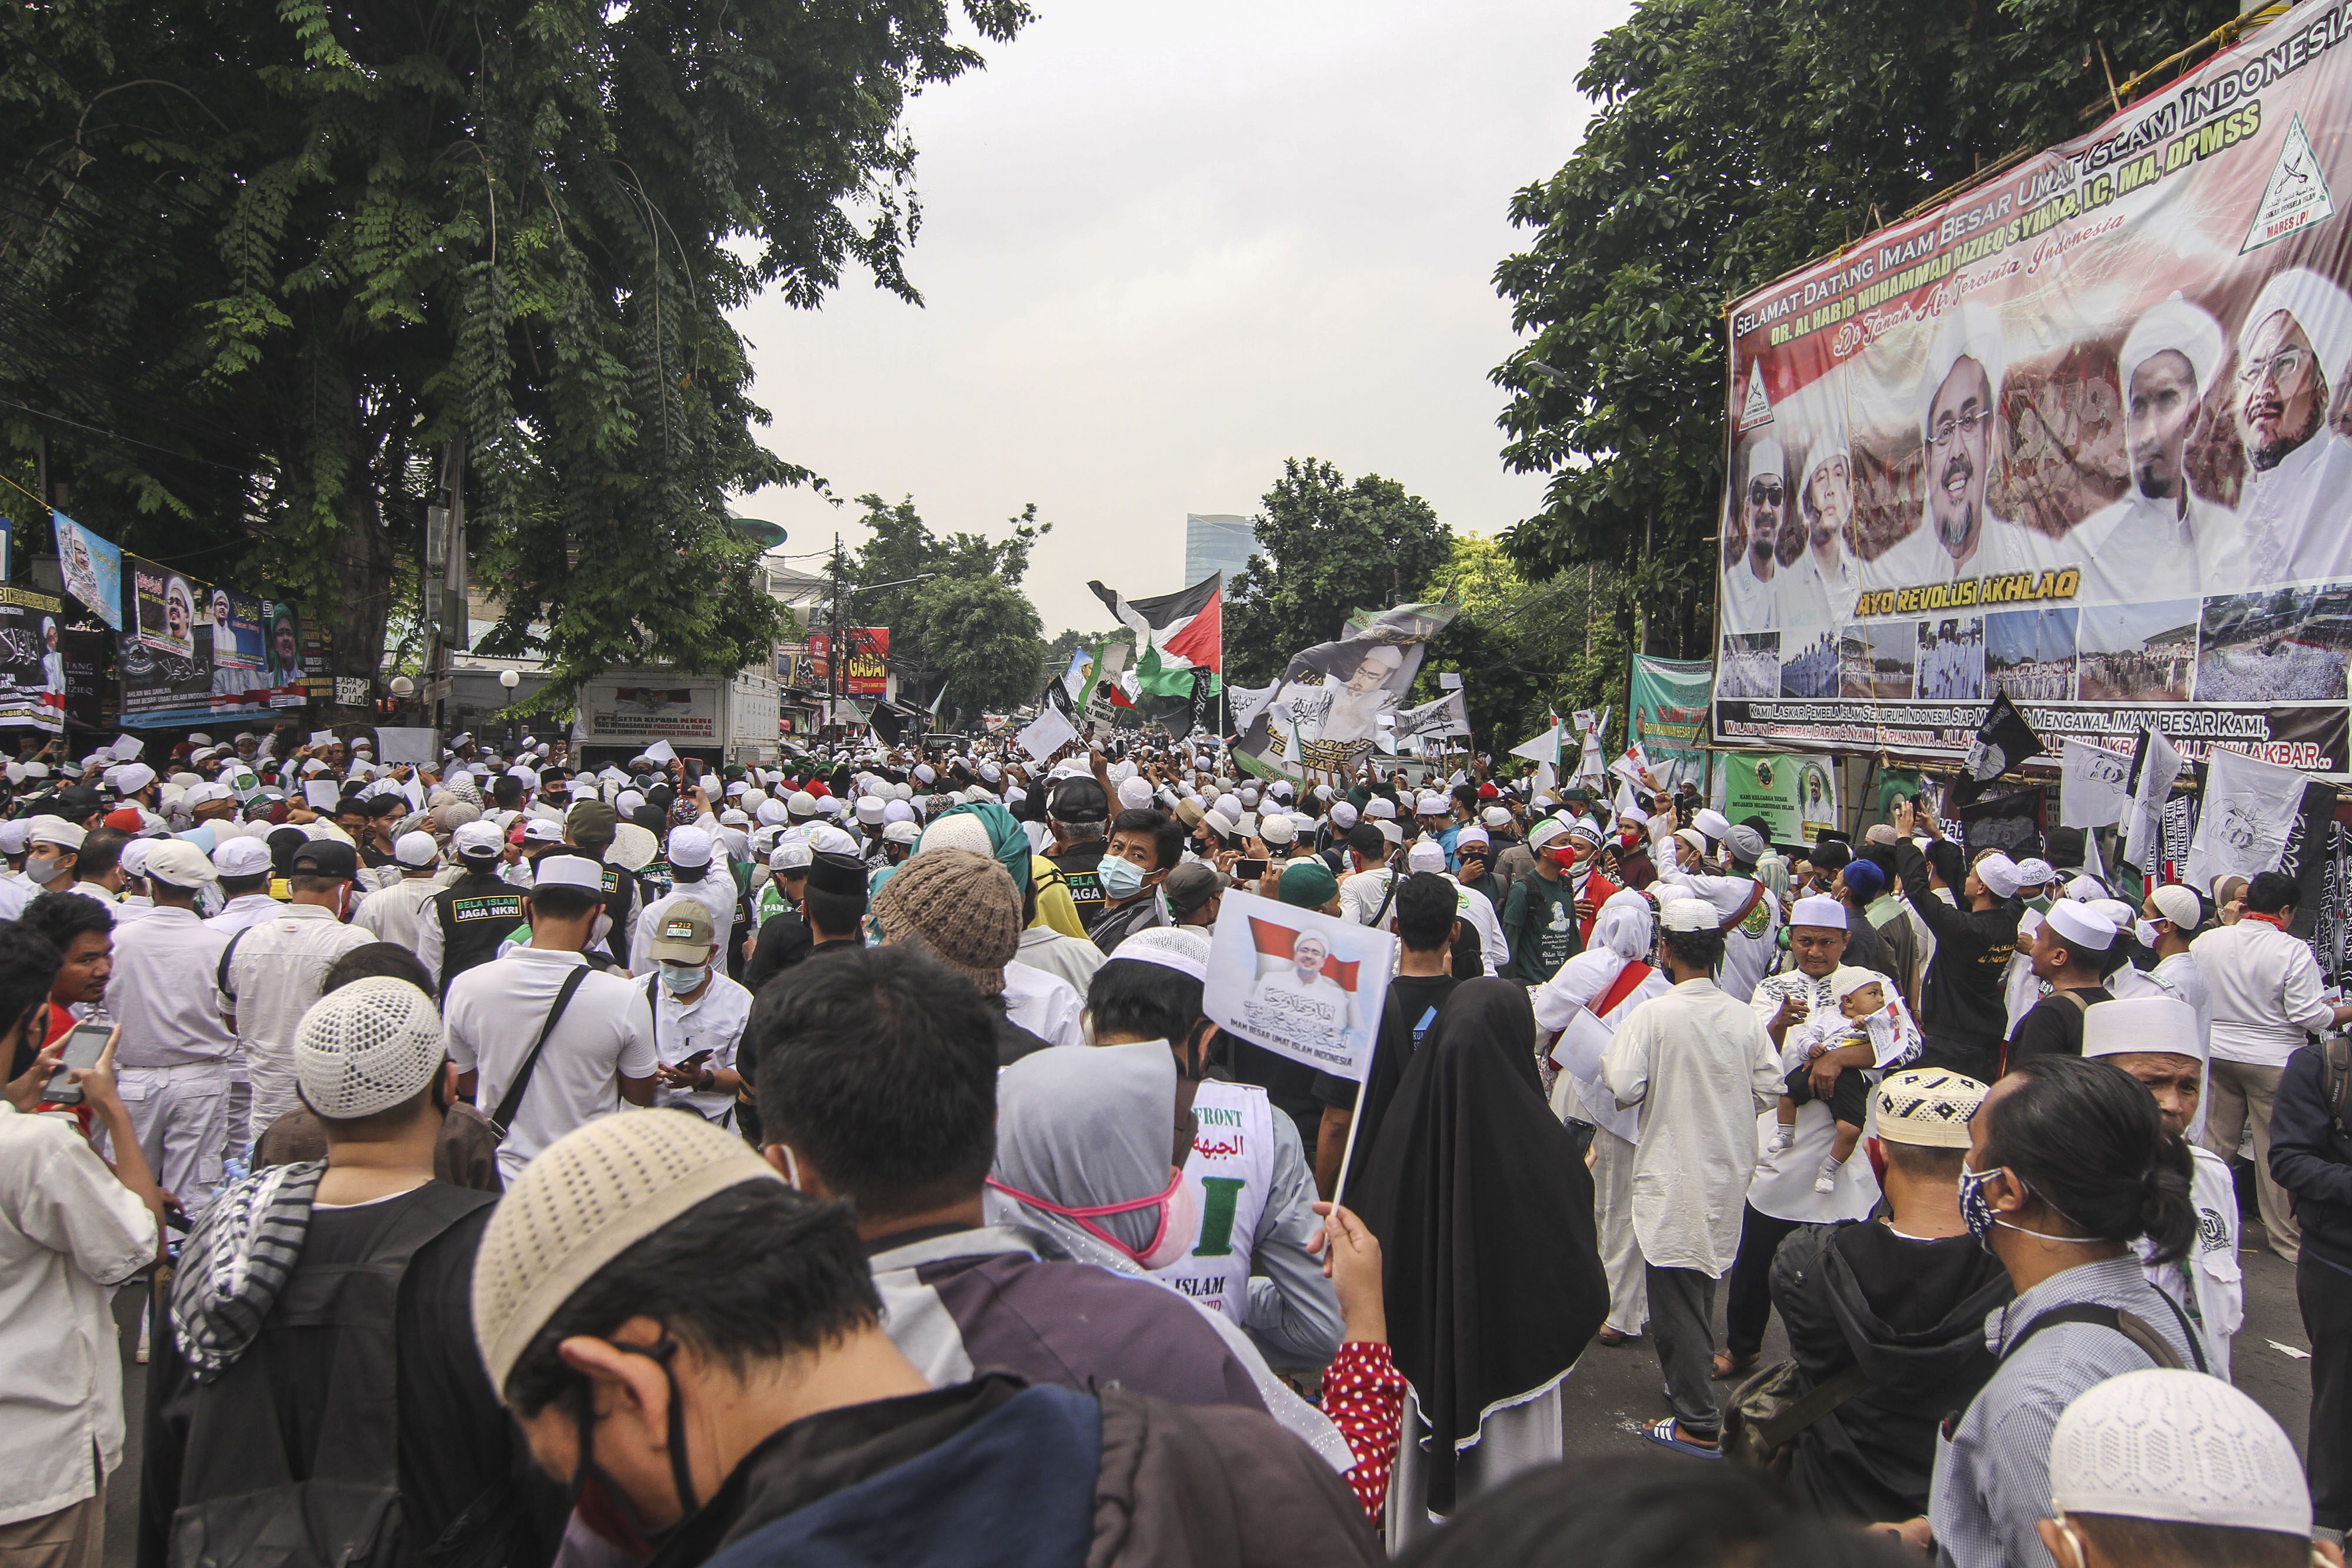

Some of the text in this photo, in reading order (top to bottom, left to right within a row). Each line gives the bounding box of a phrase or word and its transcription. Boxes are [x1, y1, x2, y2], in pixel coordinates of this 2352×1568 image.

[1736, 1, 2352, 337] SELAMAT DATANG IMAM BESAR UMAT ISLAM INDONESIA
[1771, 103, 2259, 346] DR. AL HABIB MUHAMMAD RIZIEQ SYIHAB, LC, MA, DPMSS
[2267, 210, 2310, 239] MABES LPI
[1863, 301, 1913, 346] Tanah
[1916, 283, 1949, 322] Air
[1953, 259, 2021, 305] Tercinta
[2028, 214, 2126, 275] Indonesia
[1856, 570, 2078, 615] AYO REVOLUSI AKHLAQ
[850, 653, 885, 677] GADAI
[67, 687, 94, 696] IZIEQ
[1677, 725, 1691, 738] BESAR
[1750, 704, 1770, 718] KAMI
[1772, 705, 1805, 719] LASKAR
[1806, 705, 1839, 720] PEMBELA
[1839, 706, 1860, 721] ISLAM
[1906, 707, 1950, 724] INDONESIA
[1952, 708, 1974, 725] SIAP
[2033, 710, 2110, 731] MENGAWAL
[2113, 712, 2156, 731] IMAM
[2159, 712, 2216, 735] BESAR
[2219, 712, 2269, 740] KAMI,
[1768, 723, 1812, 737] BERSIMBAH
[1813, 724, 1839, 739] DARAH
[1840, 724, 1846, 740] &
[1847, 725, 1874, 741] NYAWA
[1940, 818, 1963, 841] Hab
[2166, 803, 2176, 836] PALESTI
[2176, 816, 2187, 855] PALESTINE
[640, 864, 657, 873] BELA
[643, 870, 661, 880] JAGA
[457, 898, 517, 910] BELA ISLAM
[1068, 887, 1101, 900] AGA
[459, 906, 518, 919] JAGA NKRI
[764, 904, 784, 912] PAM
[1230, 1018, 1352, 1067] IMAM BESAR UMAT ISLAM INDONESIA
[1194, 1107, 1243, 1128] FRONT
[1175, 1276, 1226, 1296] ISLAM
